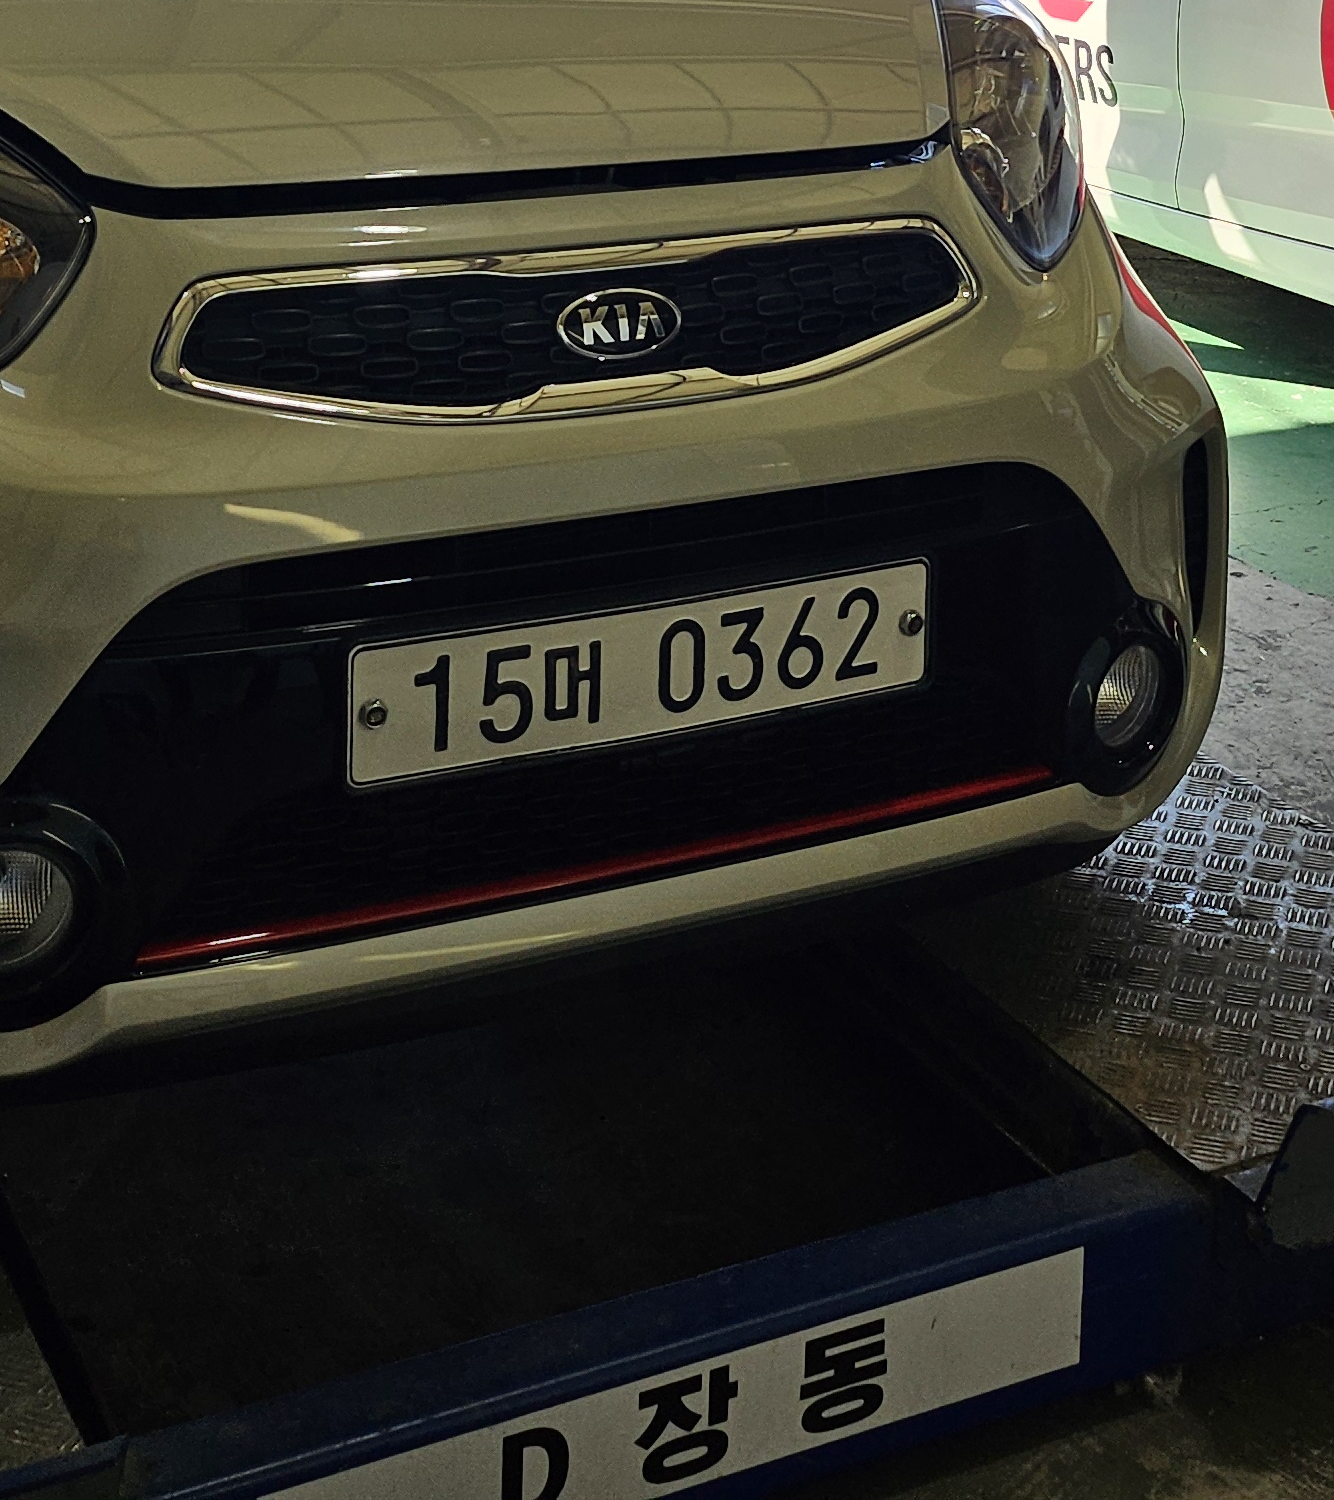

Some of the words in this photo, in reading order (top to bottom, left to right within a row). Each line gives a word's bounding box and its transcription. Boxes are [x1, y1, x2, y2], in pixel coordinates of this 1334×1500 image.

[577, 301, 665, 345] KIA
[414, 640, 602, 752] 15머
[658, 587, 880, 713] 0362
